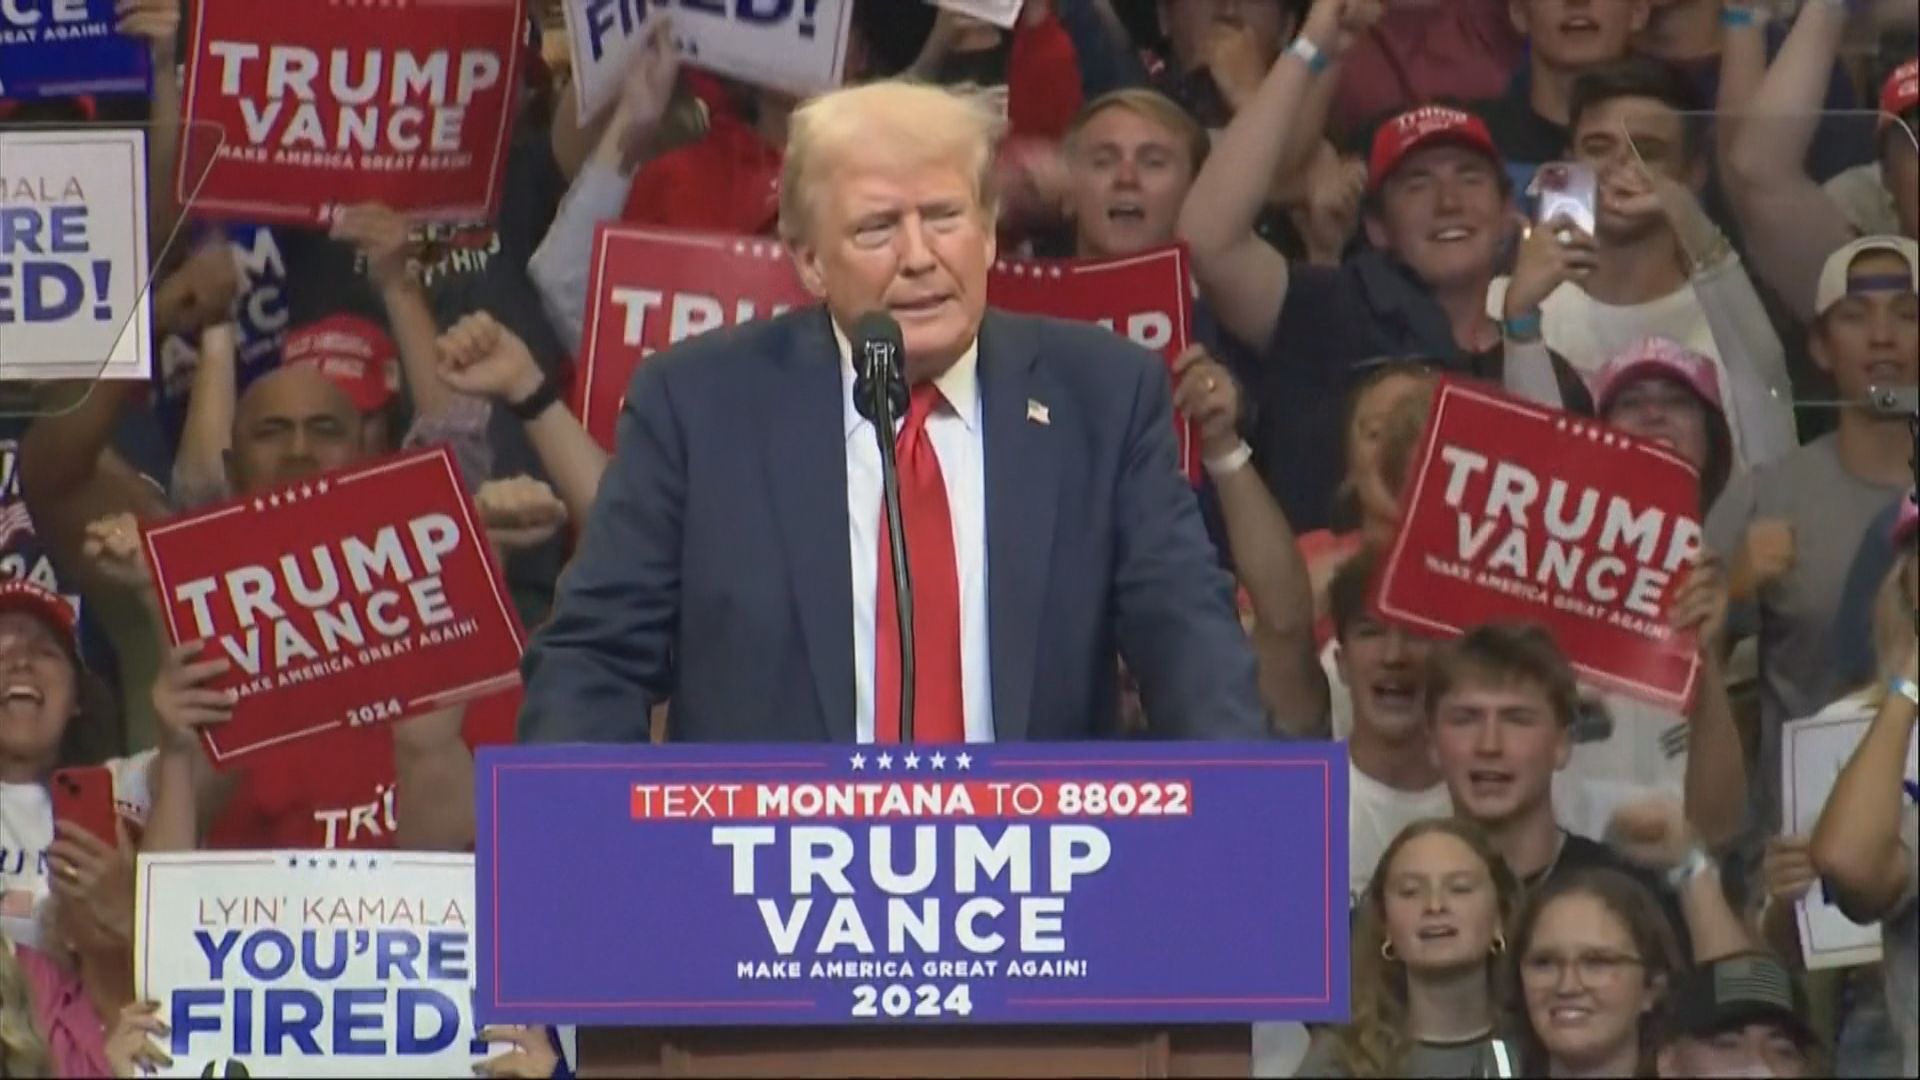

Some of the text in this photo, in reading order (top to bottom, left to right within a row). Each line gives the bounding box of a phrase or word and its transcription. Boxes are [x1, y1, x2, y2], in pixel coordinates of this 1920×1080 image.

[208, 40, 500, 105] TRUMP
[240, 99, 465, 152] VANCE
[274, 150, 355, 170] AMERICA
[360, 154, 414, 171] GREAT
[1441, 445, 1704, 573] TRUMP
[174, 512, 461, 640] TRUMP
[1457, 512, 1670, 618] VANCE
[218, 574, 455, 676] VANCE
[278, 656, 355, 689] AMERICA
[359, 638, 413, 665] GREAT
[419, 618, 480, 648] AGAIN!
[346, 697, 403, 728] 2024
[636, 782, 1188, 818] TEXT MONTANA TO 88022
[711, 824, 1112, 895] TRUMP
[198, 896, 467, 927] LYIN' KAMALA
[756, 896, 1066, 956] VANCE
[193, 929, 470, 982] YOU'RE
[737, 959, 1089, 979] MAKE AMERICA GREAT AGAIN!
[851, 982, 974, 1018] 2024
